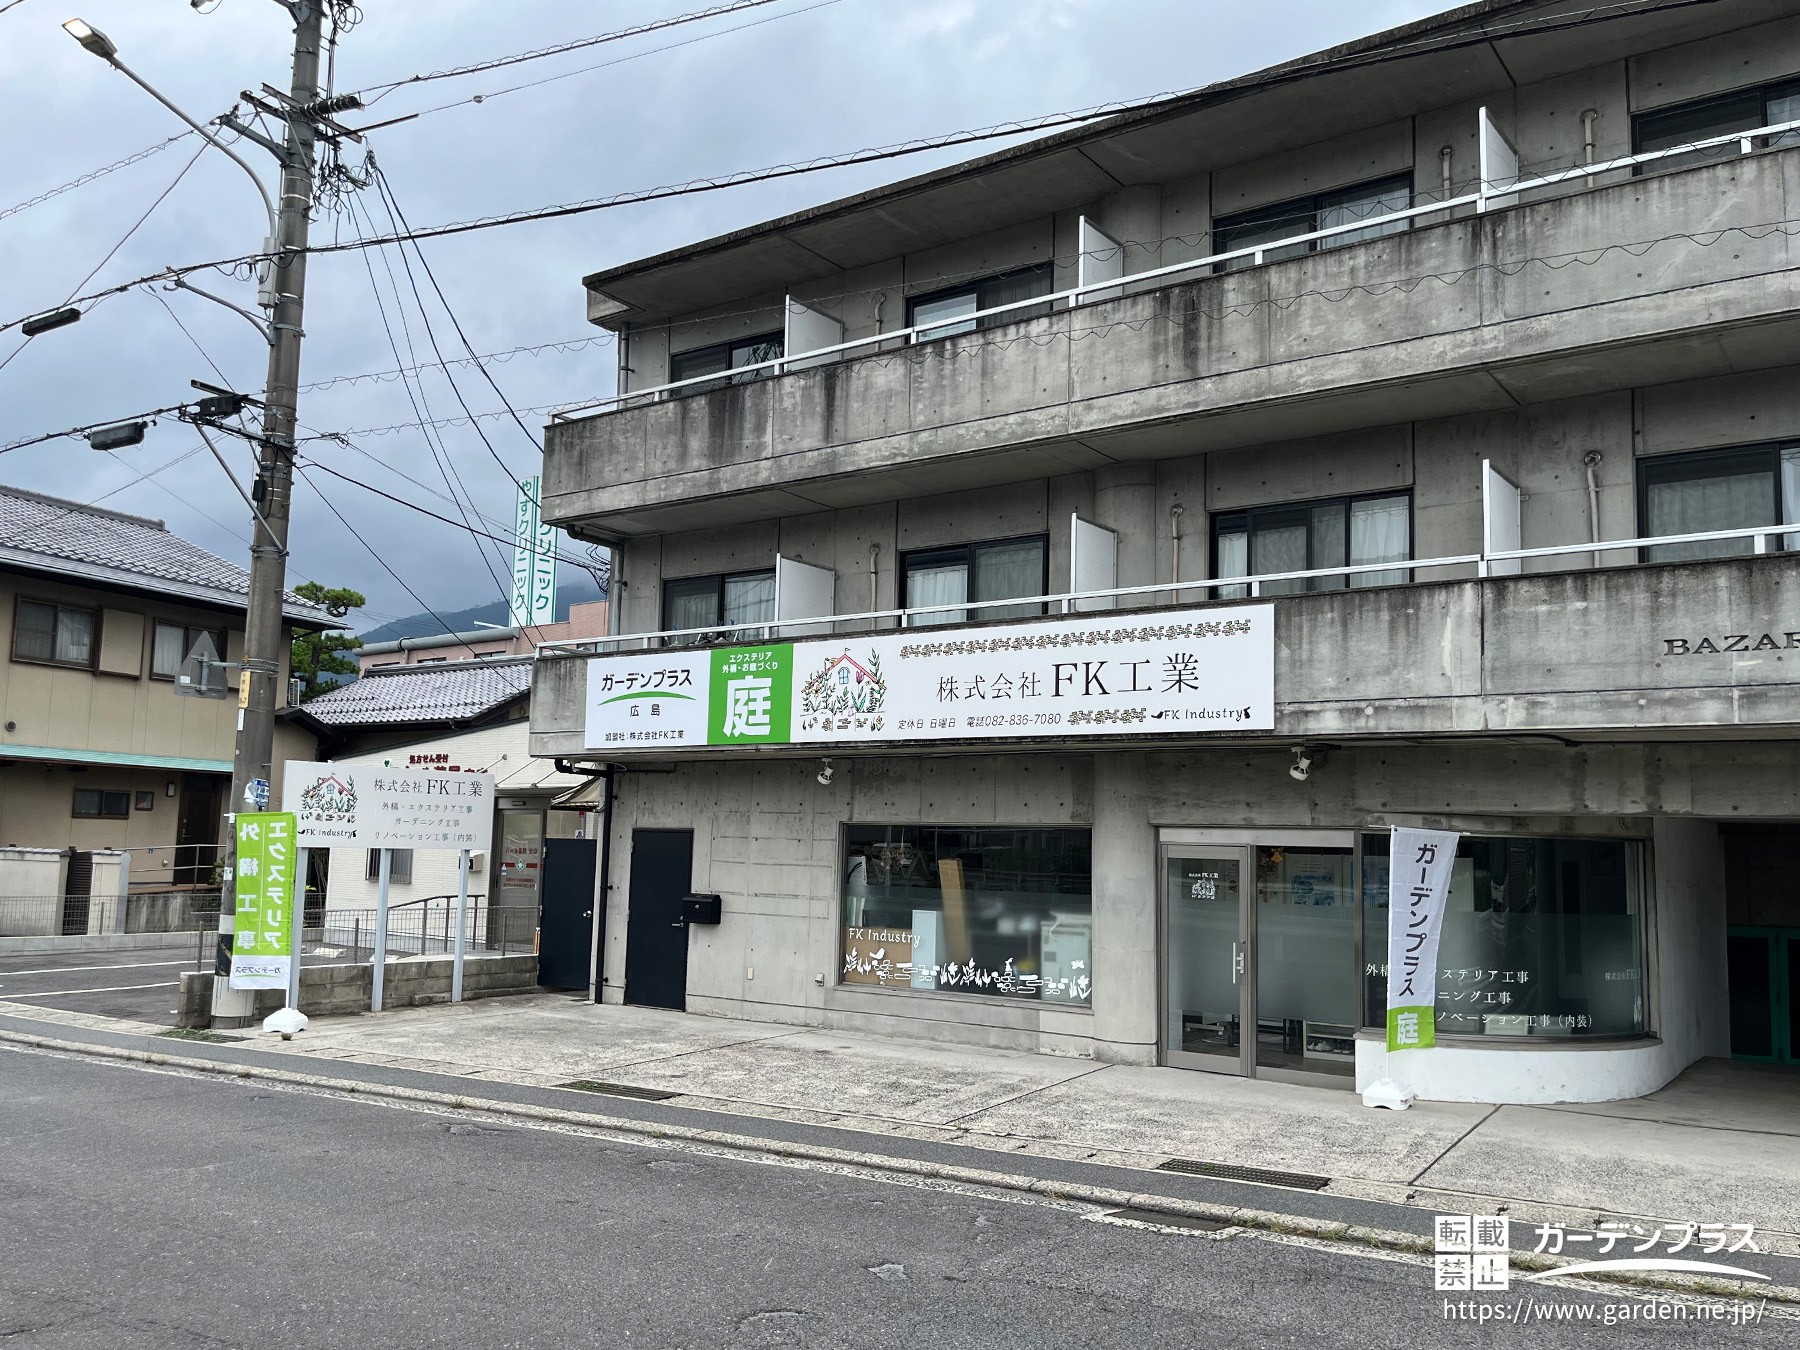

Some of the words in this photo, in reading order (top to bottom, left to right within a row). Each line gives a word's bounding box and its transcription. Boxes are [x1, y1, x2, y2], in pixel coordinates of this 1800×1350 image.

[514, 479, 532, 610] やすクリニック
[729, 652, 772, 662] エクステリア
[601, 669, 692, 691] ガーデンプラス
[723, 675, 772, 738] 庭
[1164, 709, 1180, 719] FK
[1185, 708, 1243, 722] Industry
[394, 817, 460, 828] ガーデニング工事
[1399, 843, 1438, 997] ガーデンプラス
[849, 927, 864, 940] FK
[868, 928, 920, 948] Industry
[1397, 1012, 1420, 1045] 庭
